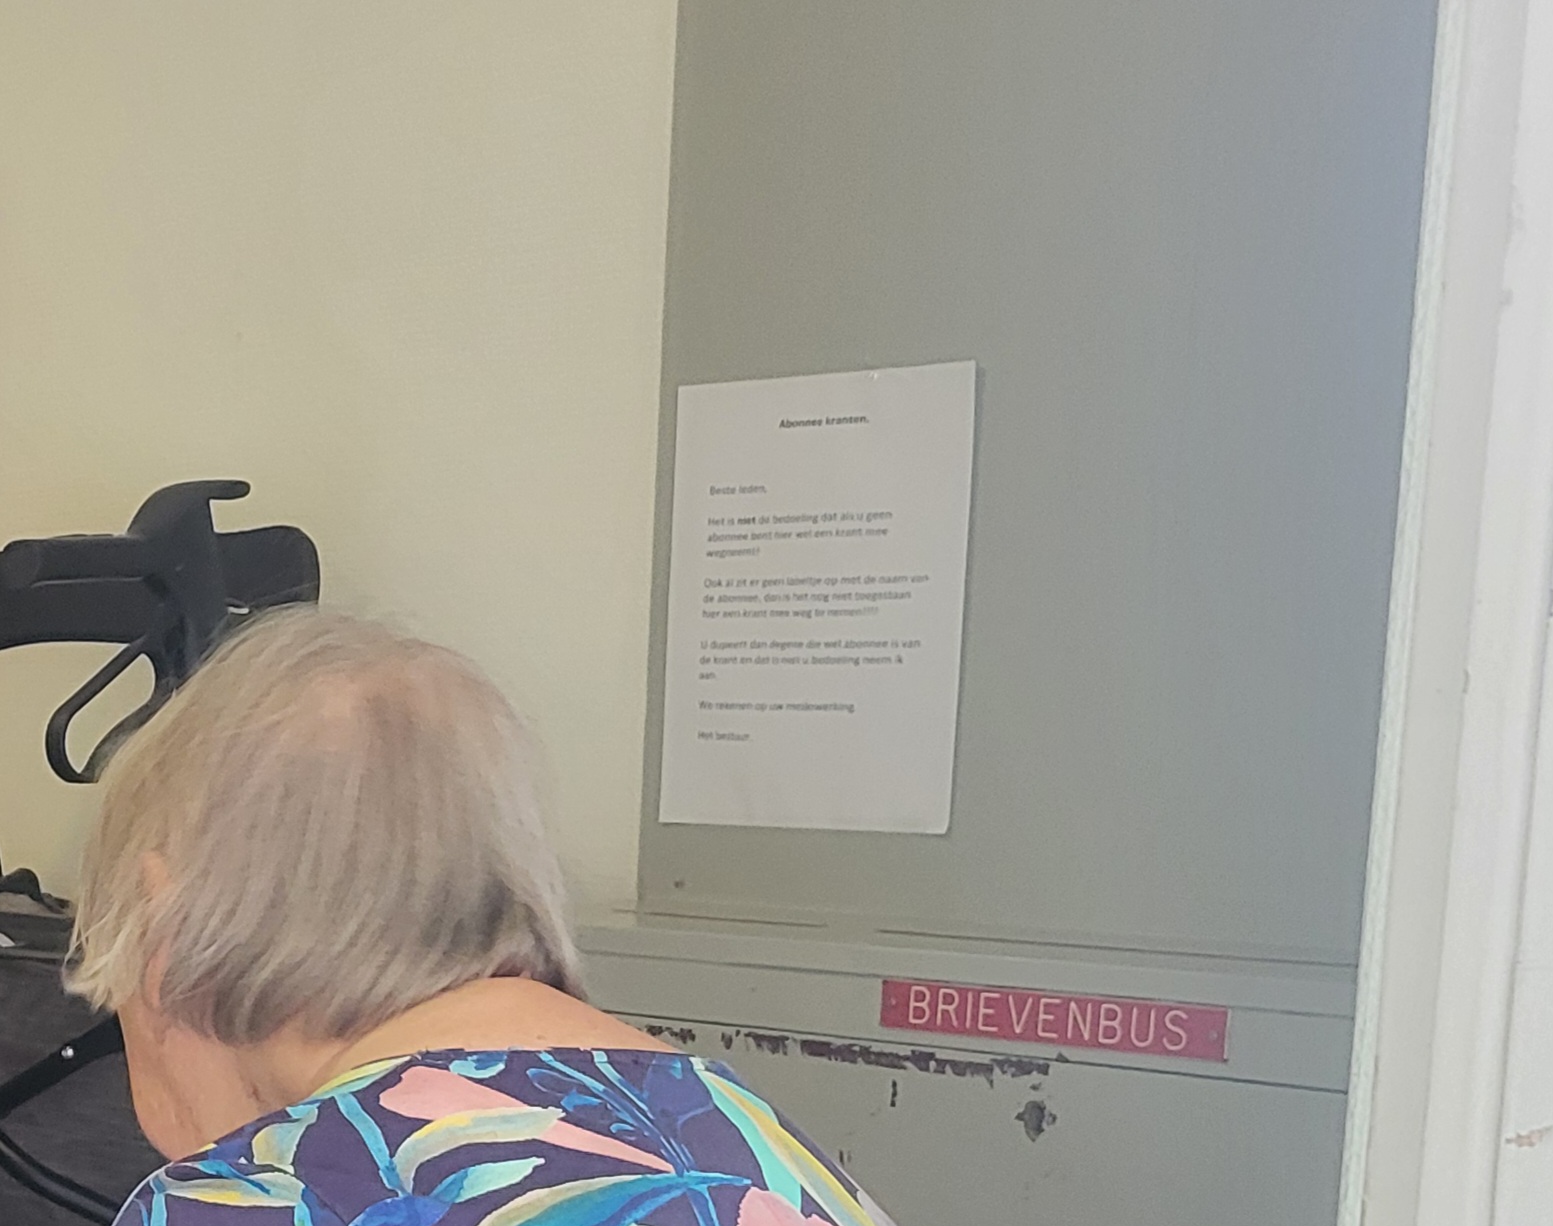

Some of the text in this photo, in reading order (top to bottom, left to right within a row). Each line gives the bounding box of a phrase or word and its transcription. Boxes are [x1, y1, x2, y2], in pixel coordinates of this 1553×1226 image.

[779, 416, 870, 429] Abonnee kranten.
[907, 985, 1189, 1051] BRIEVENBUS
